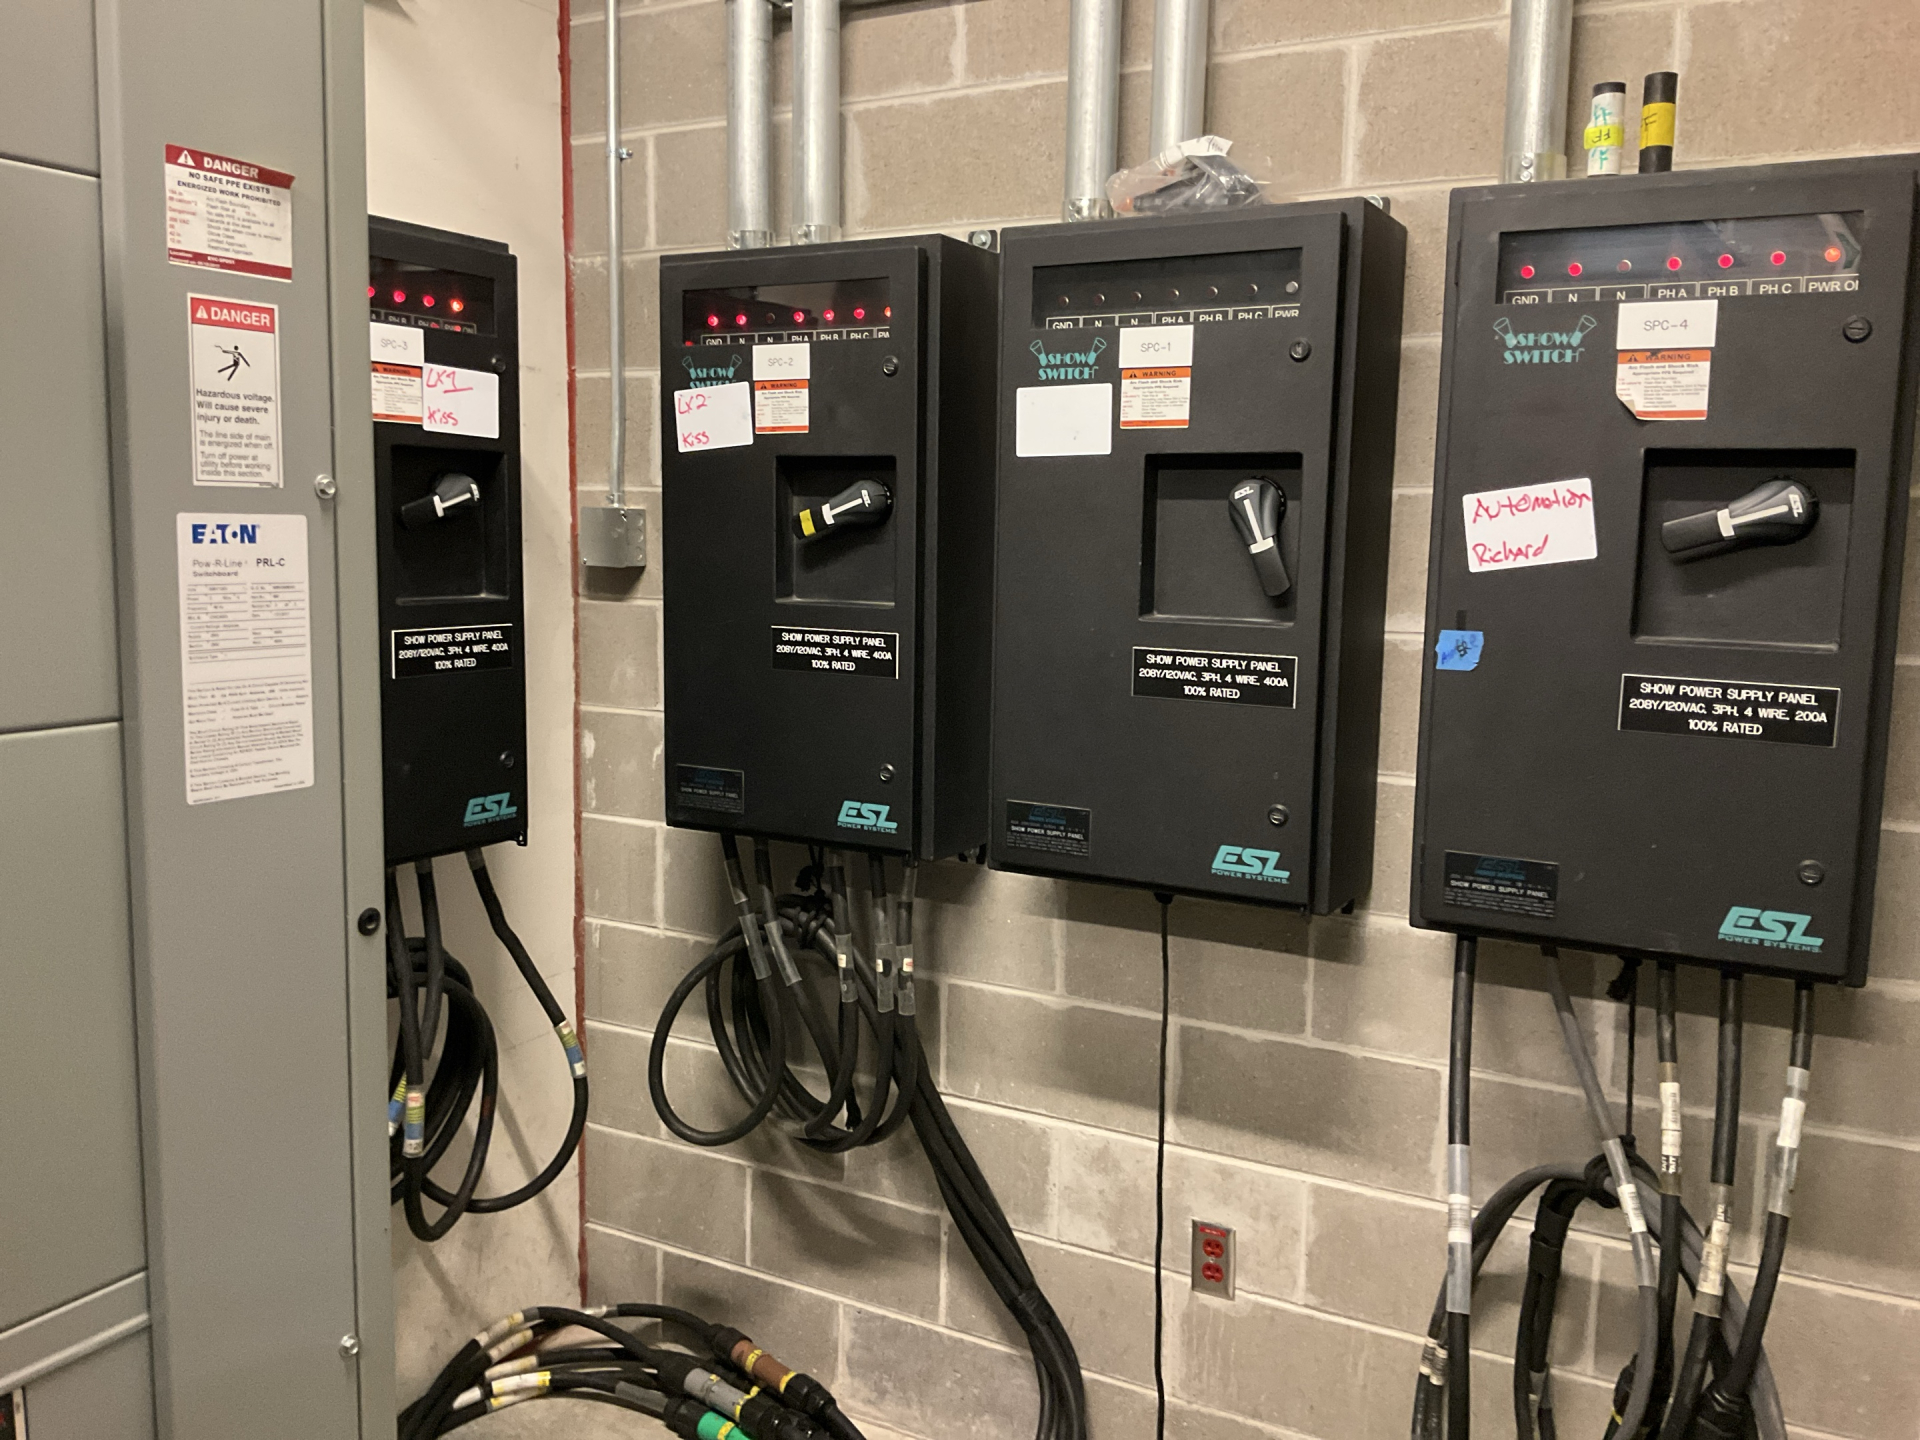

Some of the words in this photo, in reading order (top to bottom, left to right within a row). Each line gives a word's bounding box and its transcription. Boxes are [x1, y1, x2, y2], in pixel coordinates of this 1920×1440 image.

[203, 156, 259, 178] DANGER
[189, 172, 201, 180] NO
[203, 174, 223, 185] SAFE
[226, 179, 240, 188] PPE
[243, 182, 270, 194] EXISTS
[177, 180, 217, 193] ENERGIZED
[219, 189, 240, 198] WORK
[242, 194, 281, 206] PROHIBITED
[1708, 286, 1726, 296] PH
[1730, 286, 1738, 296] B
[1759, 284, 1778, 294] PH
[1782, 283, 1792, 293] C
[1808, 281, 1840, 292] PWR
[1569, 293, 1578, 302] N
[1616, 291, 1626, 300] N
[1658, 289, 1675, 298] PH
[1674, 288, 1688, 298] A
[1512, 295, 1538, 304] GND
[211, 307, 270, 326] DANGER
[1162, 316, 1176, 324] PH
[1176, 316, 1184, 324] A
[1275, 310, 1299, 318] PWR
[1644, 319, 1688, 331] SPC-4
[381, 338, 408, 350] SPC-3
[1517, 332, 1571, 347] SHOW
[1141, 342, 1171, 352] SPC-1
[1048, 354, 1088, 366] SHOW
[1503, 348, 1584, 364] SWITCH
[768, 358, 794, 367] SPC-2
[696, 368, 727, 378] SHOW
[1038, 366, 1098, 380] SWITCH
[196, 389, 241, 399] Hazardous
[243, 393, 274, 404] voltage.
[197, 401, 212, 409] Will
[215, 403, 239, 411] cause
[242, 405, 268, 413] severe
[197, 413, 221, 424] injury
[235, 416, 260, 425] death.
[200, 430, 213, 438] The
[682, 431, 710, 447] Kiss
[208, 440, 242, 449] energized
[192, 524, 257, 544] EATON
[1472, 534, 1549, 566] Richard
[256, 558, 285, 567] PRL-C
[404, 636, 425, 645] SHOW
[428, 634, 452, 643] POWER
[455, 632, 480, 641] SUPPLY
[482, 631, 503, 639] PANEL
[782, 632, 802, 641] SHOW
[805, 634, 830, 643] POWER
[833, 636, 860, 645] SUPPLY
[863, 638, 886, 647] PANEL
[873, 652, 892, 660] 400A
[435, 661, 452, 669] 100%
[454, 658, 477, 668] RATED
[812, 660, 829, 669] 100%
[832, 661, 855, 671] RATED
[1146, 654, 1173, 664] SHOW
[1176, 656, 1208, 667] POWER
[1212, 658, 1247, 670] SUPPLY
[1251, 661, 1281, 672] PANEL
[1225, 674, 1232, 683] 4
[1264, 677, 1288, 687] 400A
[1184, 686, 1206, 696] 100%
[1210, 688, 1240, 698] RATED
[1640, 683, 1675, 694] SHOW
[1679, 686, 1722, 698] POWER
[1727, 689, 1774, 701] SUPPLY
[1778, 693, 1818, 706] PANEL
[1744, 707, 1753, 716] 4
[1795, 711, 1827, 723] 200A
[1688, 719, 1718, 731] 100%
[1723, 722, 1763, 735] RATED
[464, 792, 518, 822] ESL
[838, 800, 898, 828] ESL
[864, 825, 897, 834] SYSTEMS
[1068, 832, 1084, 840] PANEL
[1212, 845, 1290, 878] ESL
[1211, 869, 1242, 877] POWER
[1245, 873, 1290, 884] SYSTEMS
[1472, 883, 1496, 891] POWER
[1498, 886, 1524, 895] SUPPLY
[1526, 889, 1549, 898] PANEL
[1719, 906, 1824, 946] ESL
[1718, 934, 1759, 945] POWER
[1764, 940, 1822, 953] SYSTEMS
